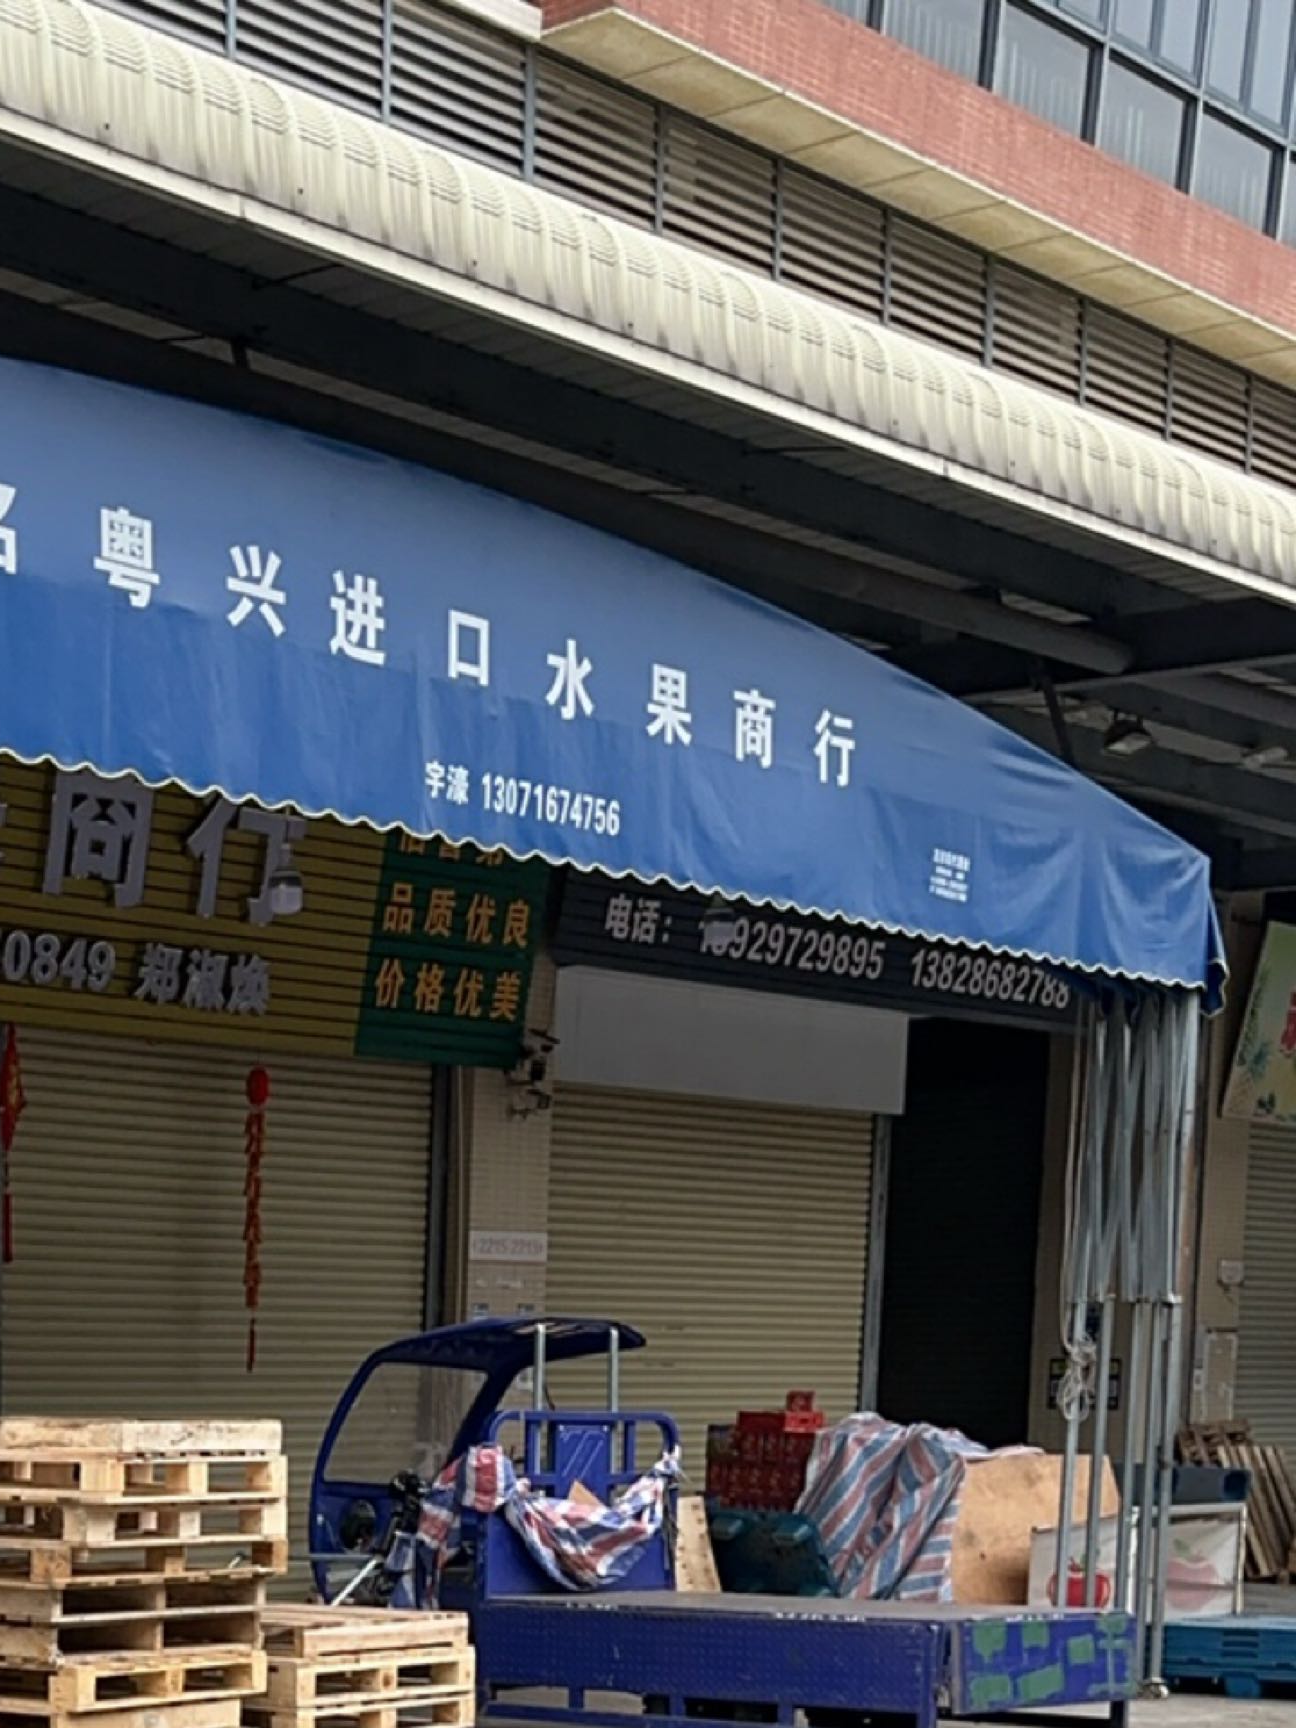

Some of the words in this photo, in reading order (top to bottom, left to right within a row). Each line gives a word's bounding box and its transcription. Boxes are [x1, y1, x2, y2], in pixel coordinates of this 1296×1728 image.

[481, 771, 621, 837] 13071674756
[382, 882, 532, 949] 品质优良
[375, 957, 522, 1022] 价格优美
